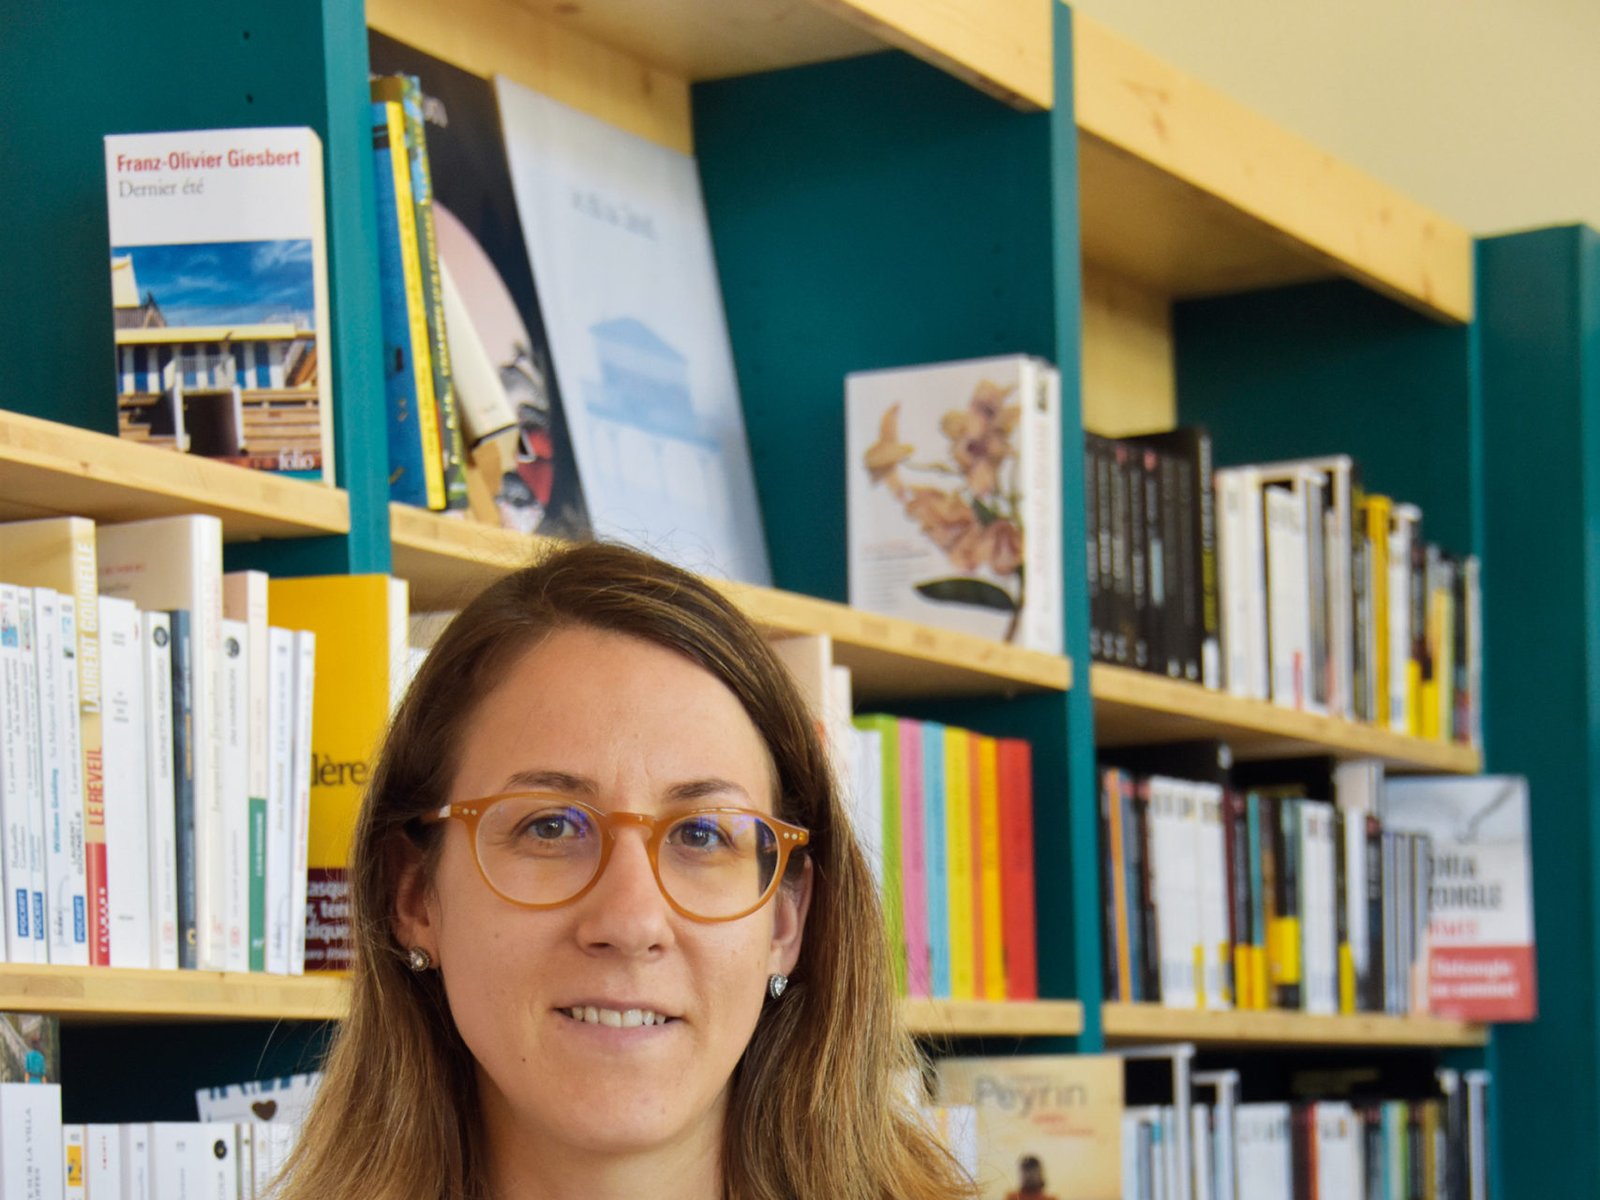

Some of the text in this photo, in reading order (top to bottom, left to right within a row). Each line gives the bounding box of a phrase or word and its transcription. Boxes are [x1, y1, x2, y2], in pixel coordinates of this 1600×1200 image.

[117, 149, 300, 173] Franz-Olivier Giesbert
[119, 177, 204, 198] Dernier été
[76, 543, 102, 713] LAURENT GOUNELLE
[312, 753, 367, 786] lère
[88, 808, 104, 826] LE
[18, 891, 27, 935] POCKET
[33, 894, 41, 938] POCKET
[75, 897, 83, 941] POCKET
[976, 1076, 1087, 1117] Peyrin
